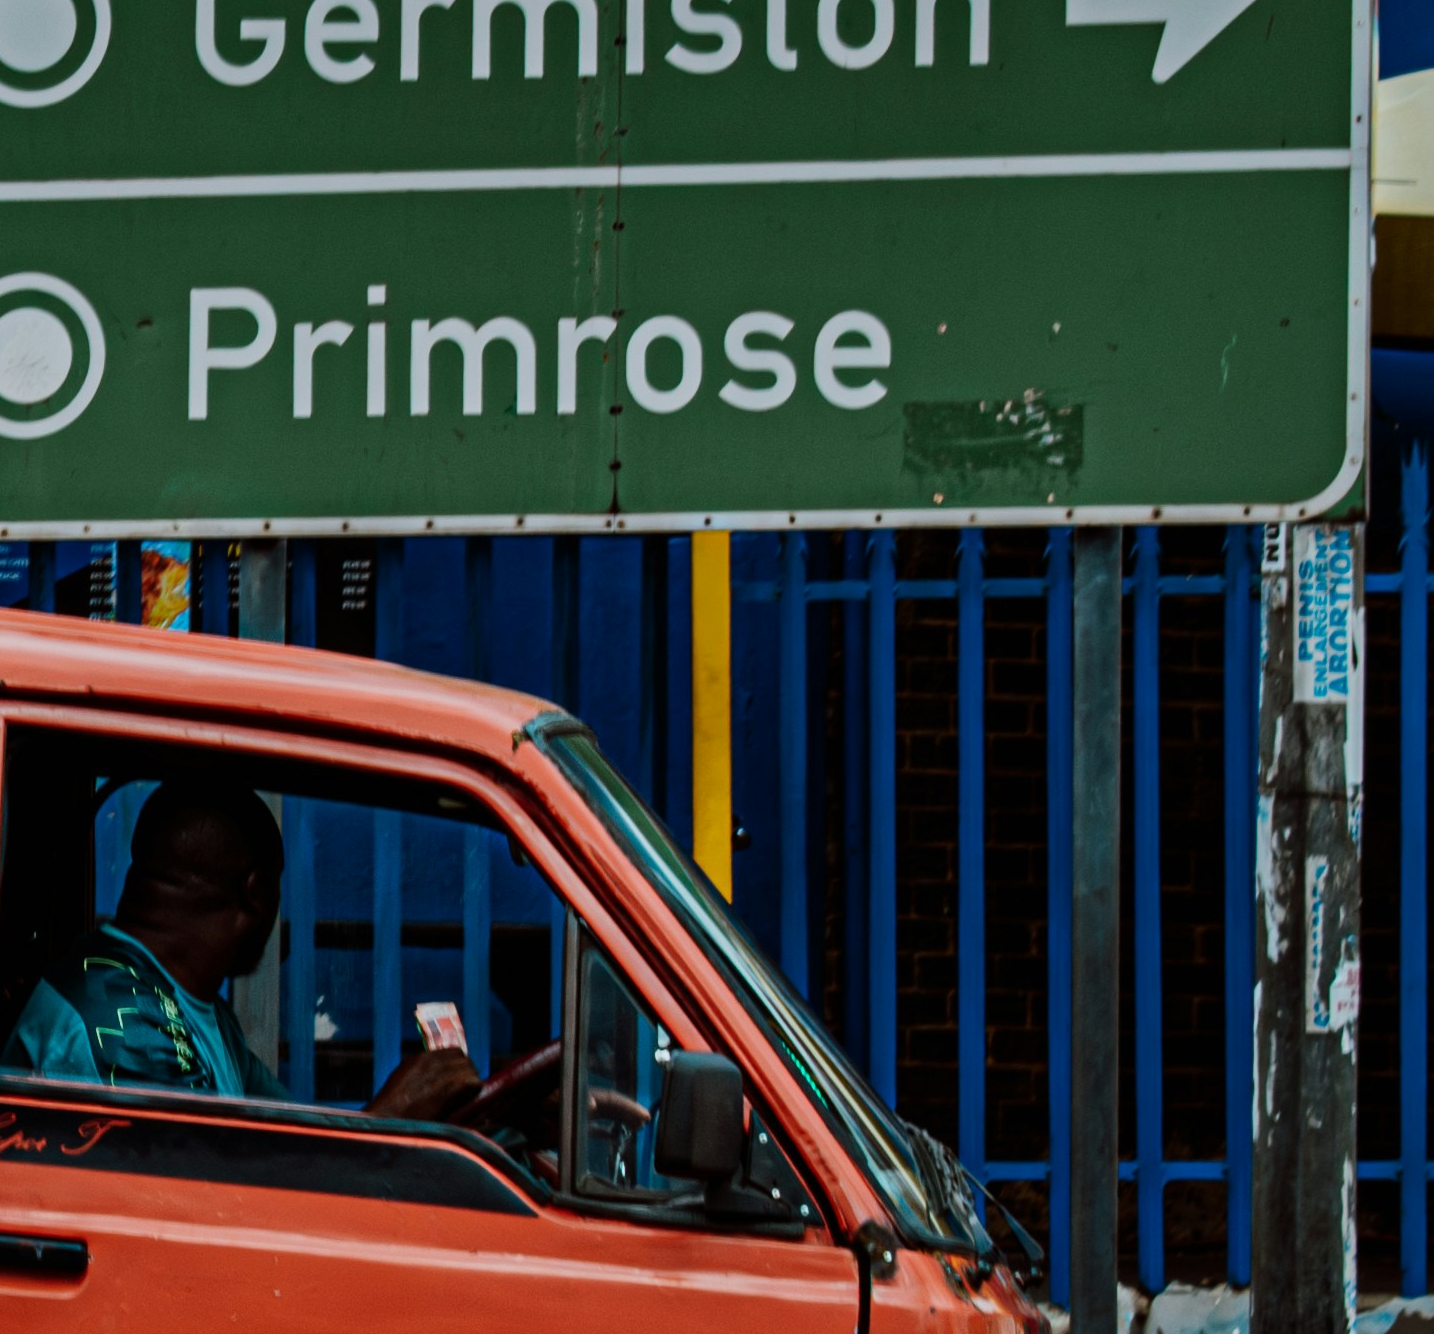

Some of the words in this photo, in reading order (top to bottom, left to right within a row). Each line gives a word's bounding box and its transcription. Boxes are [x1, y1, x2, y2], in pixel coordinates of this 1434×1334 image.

[188, 284, 892, 420] Primrose
[1297, 559, 1313, 662] PENIS
[1312, 528, 1328, 698] ENLARGEMENT
[1328, 530, 1351, 696] ABORTION
[60, 1117, 132, 1156] T
